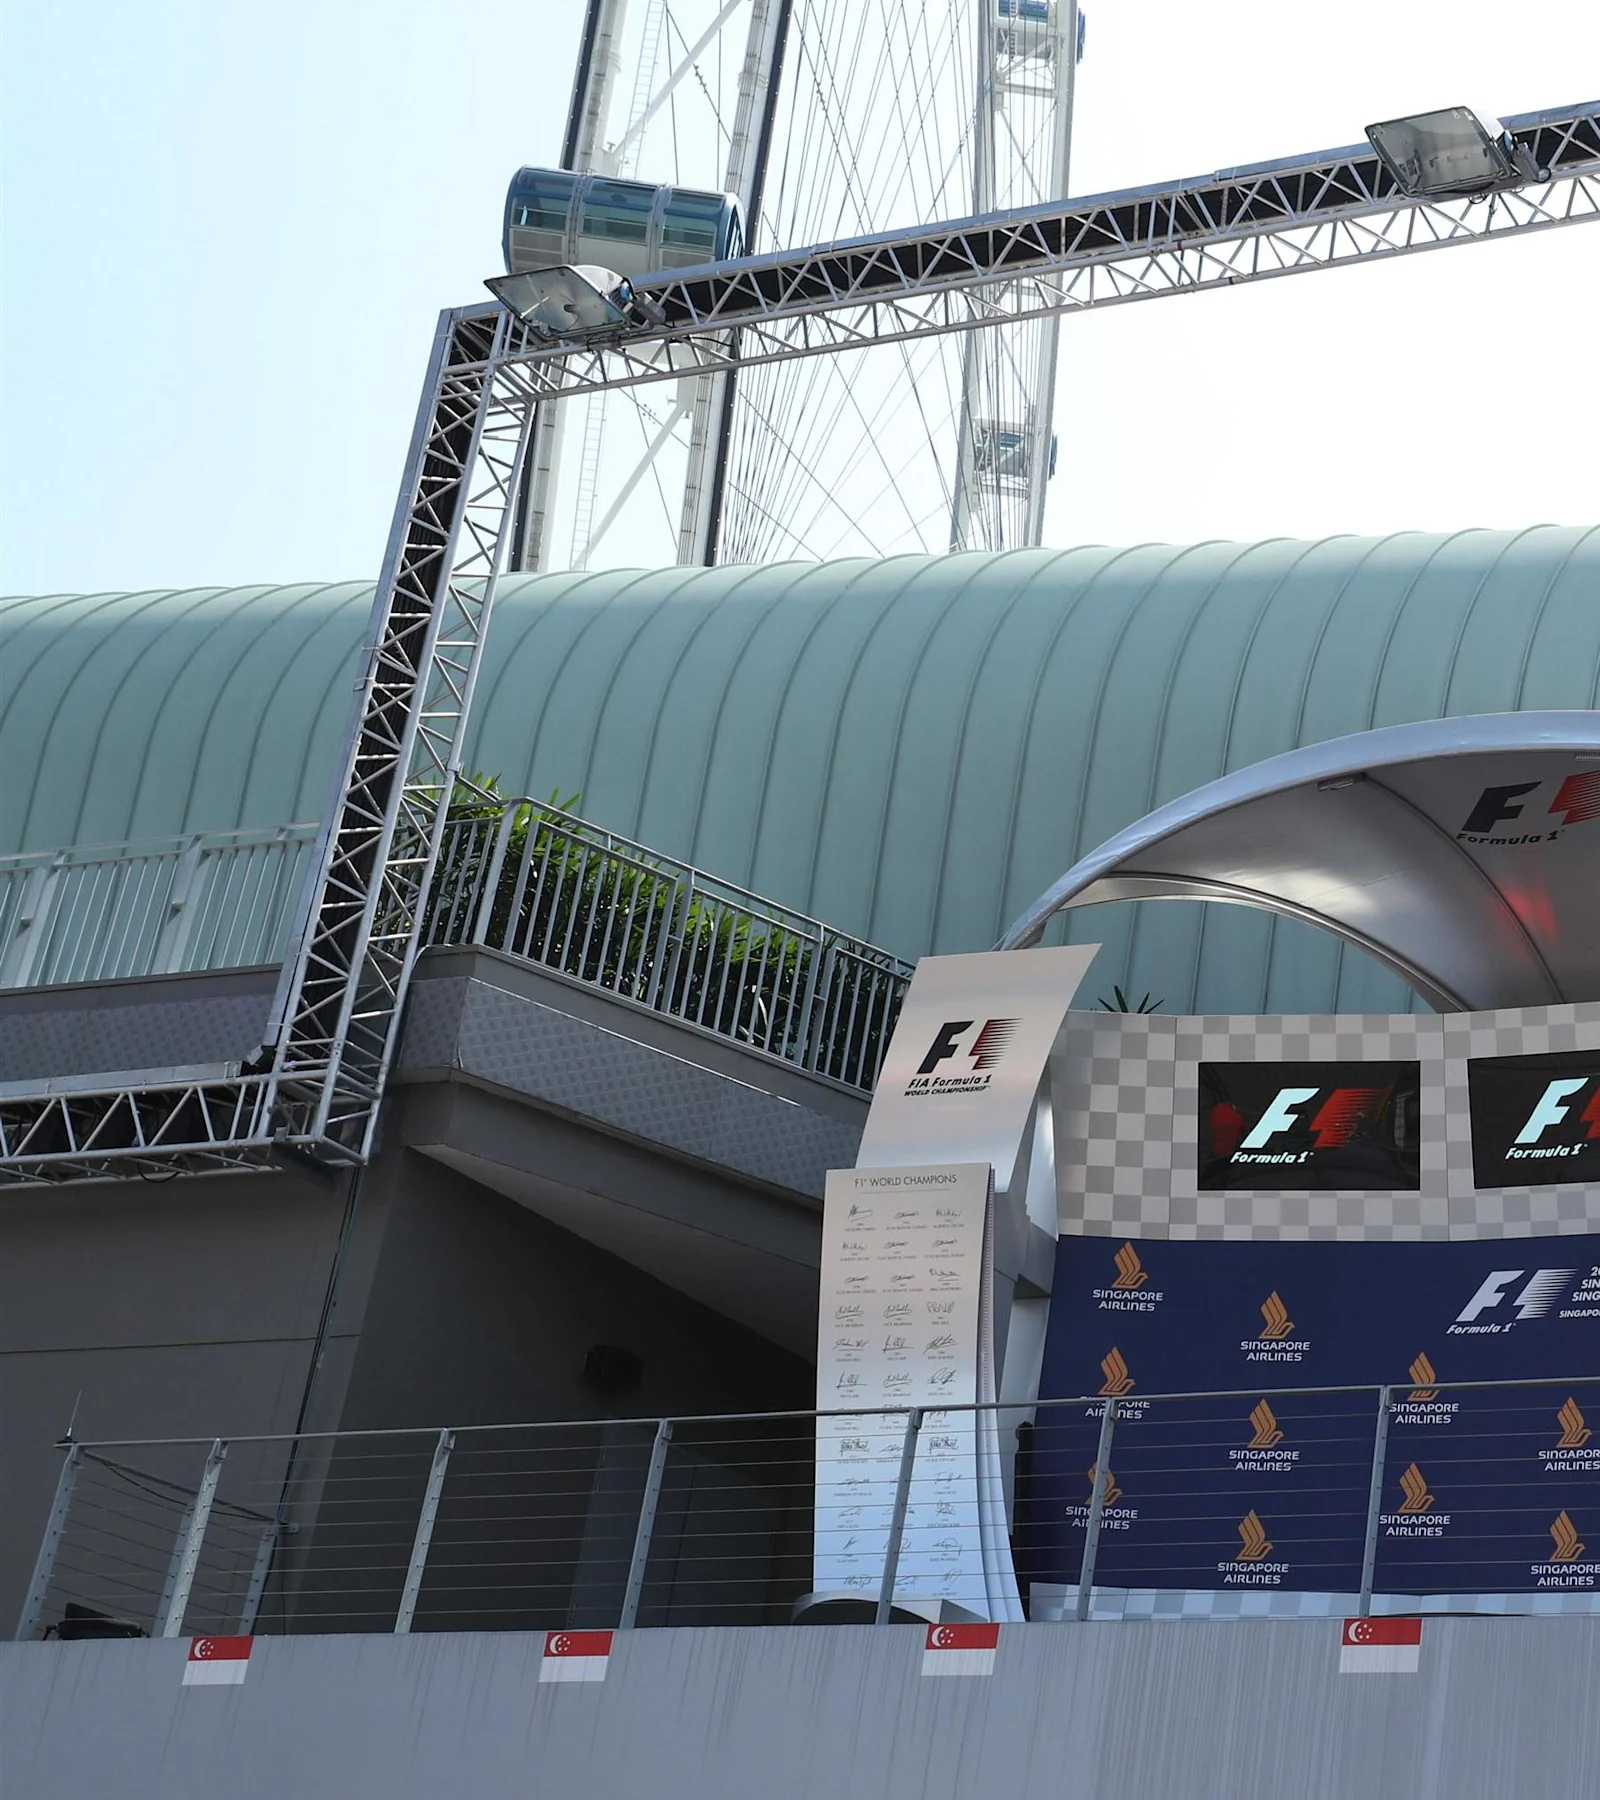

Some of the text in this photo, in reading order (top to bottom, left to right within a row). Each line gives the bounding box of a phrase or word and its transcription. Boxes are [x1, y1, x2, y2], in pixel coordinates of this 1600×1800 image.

[1456, 833, 1543, 845] Formula
[907, 1074, 992, 1089] FIA Formula 1
[904, 1086, 988, 1097] WORLD CHAMPIONSHIP
[1230, 1151, 1309, 1164] Formula 1
[1505, 1143, 1583, 1160] Formula 1
[870, 1176, 901, 1187] WORLD
[903, 1174, 957, 1185] CHAMPIONS
[1092, 1289, 1163, 1302] SINGAPORE
[1098, 1300, 1155, 1312] AIRLINES
[1446, 1322, 1511, 1335] Formula 1
[1240, 1341, 1310, 1351] SINGAPORE
[1246, 1351, 1302, 1362] AIRLINES
[1085, 1407, 1143, 1419] AIRNES
[1389, 1402, 1459, 1413] SINGAPORE
[1395, 1414, 1452, 1424] AIRLINES
[1228, 1450, 1300, 1461] SINGAPORE
[1235, 1461, 1292, 1472] AIRLINES
[1544, 1460, 1600, 1471] AIRLINES
[1065, 1505, 1139, 1519] SINPORE
[1072, 1518, 1130, 1530] AIINES
[1379, 1514, 1451, 1525] SINGAPORE
[1385, 1526, 1443, 1536] AIRLINES
[1217, 1562, 1289, 1573] SINGAPORE
[1223, 1573, 1281, 1585] AIRLINES
[1537, 1575, 1594, 1587] AIRLINES
